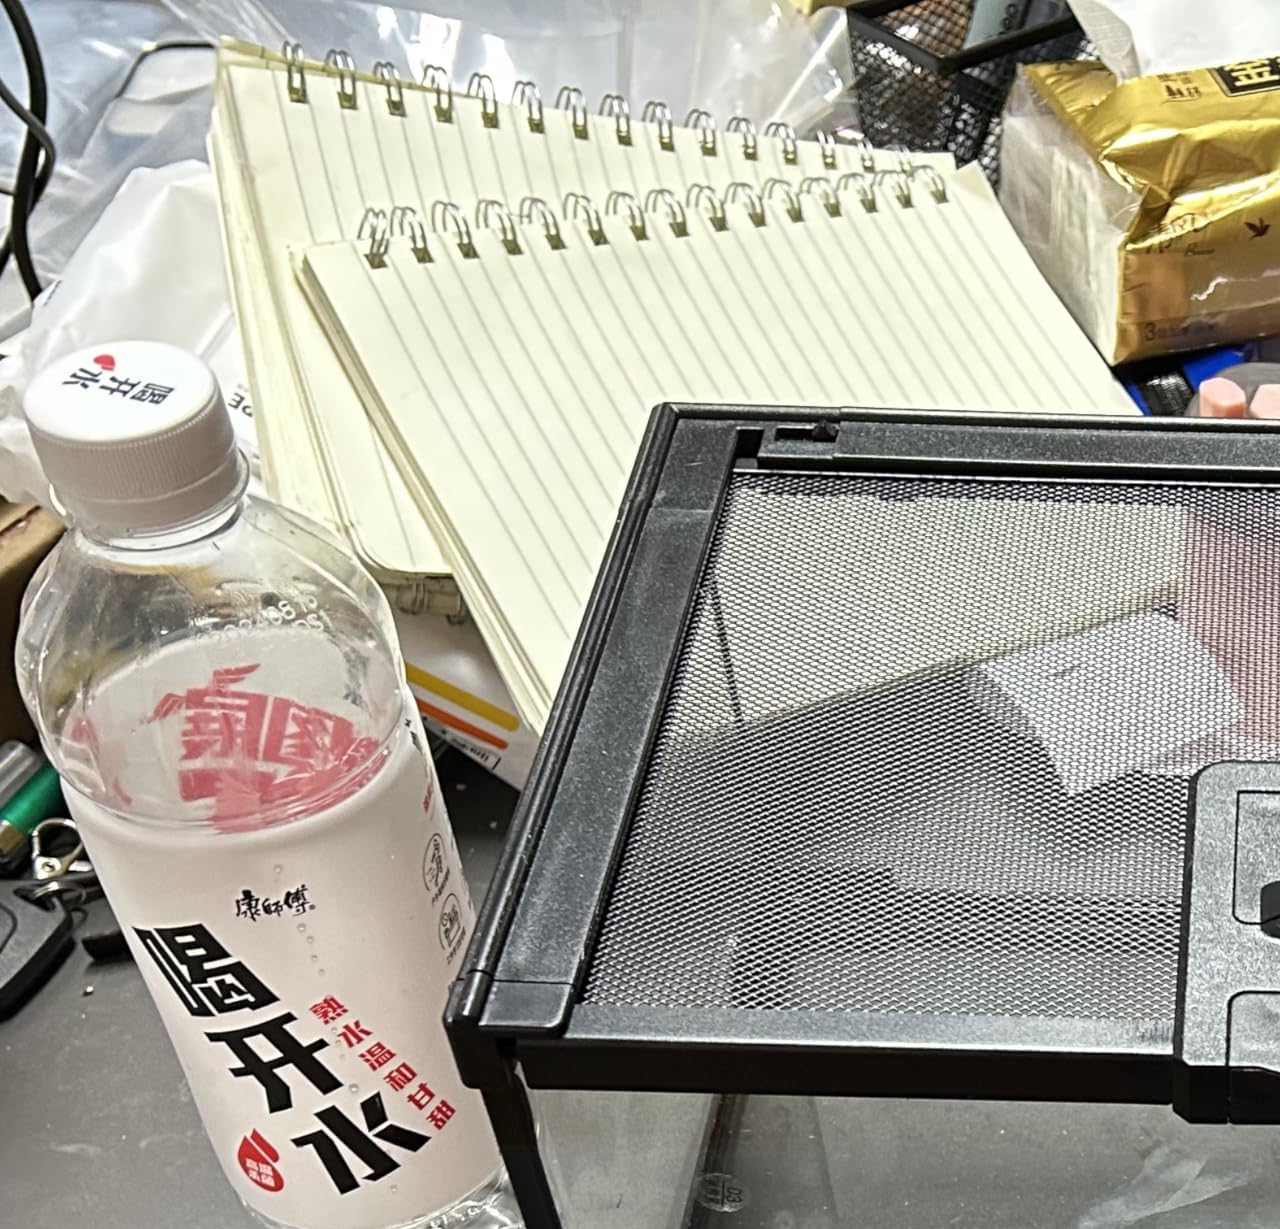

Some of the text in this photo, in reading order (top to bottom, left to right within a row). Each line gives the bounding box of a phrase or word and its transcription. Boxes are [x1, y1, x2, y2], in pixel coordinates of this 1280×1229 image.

[62, 367, 175, 405] 喝开水
[133, 923, 432, 1194] 喝开水
[309, 996, 457, 1130] 熟水温和甘甜
